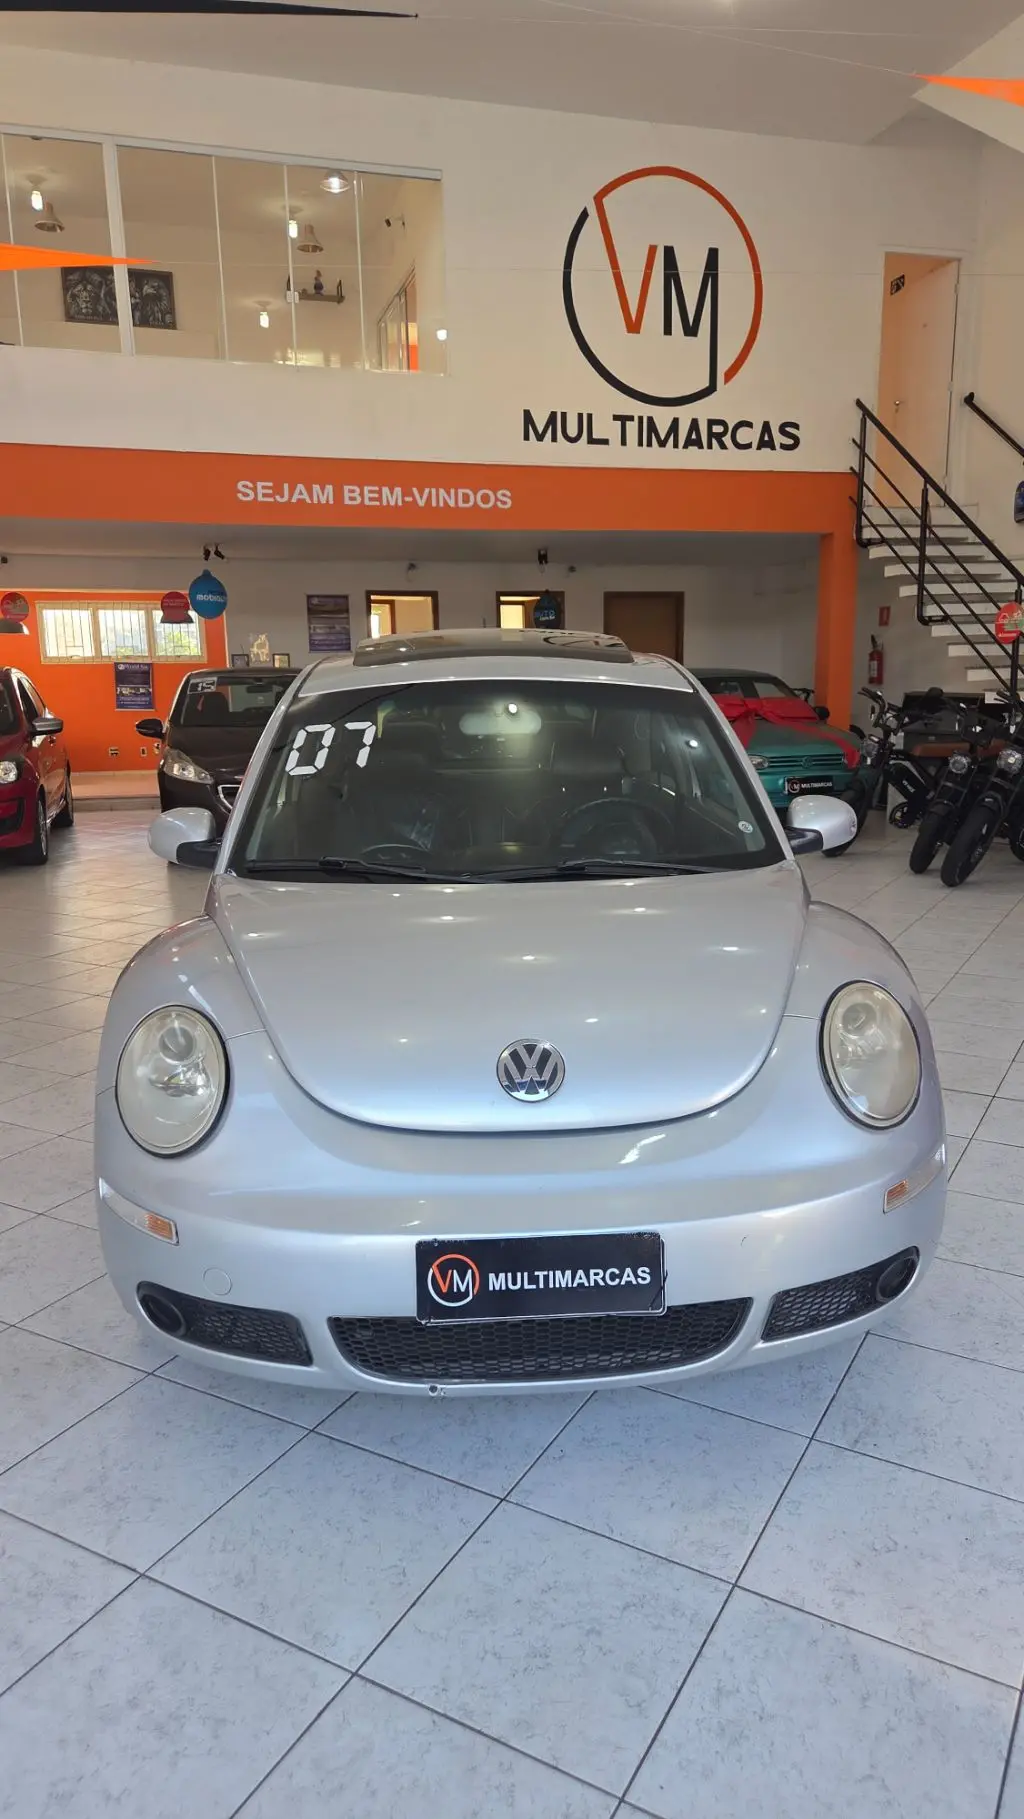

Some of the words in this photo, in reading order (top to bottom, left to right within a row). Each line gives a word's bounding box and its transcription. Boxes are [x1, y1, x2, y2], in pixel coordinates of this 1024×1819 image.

[522, 408, 801, 451] MULTIMARCAS
[236, 480, 334, 504] SEJAM
[343, 485, 512, 509] BEM-VINDOS
[285, 721, 376, 776] 07
[488, 1266, 651, 1291] MULTIMARCAS
